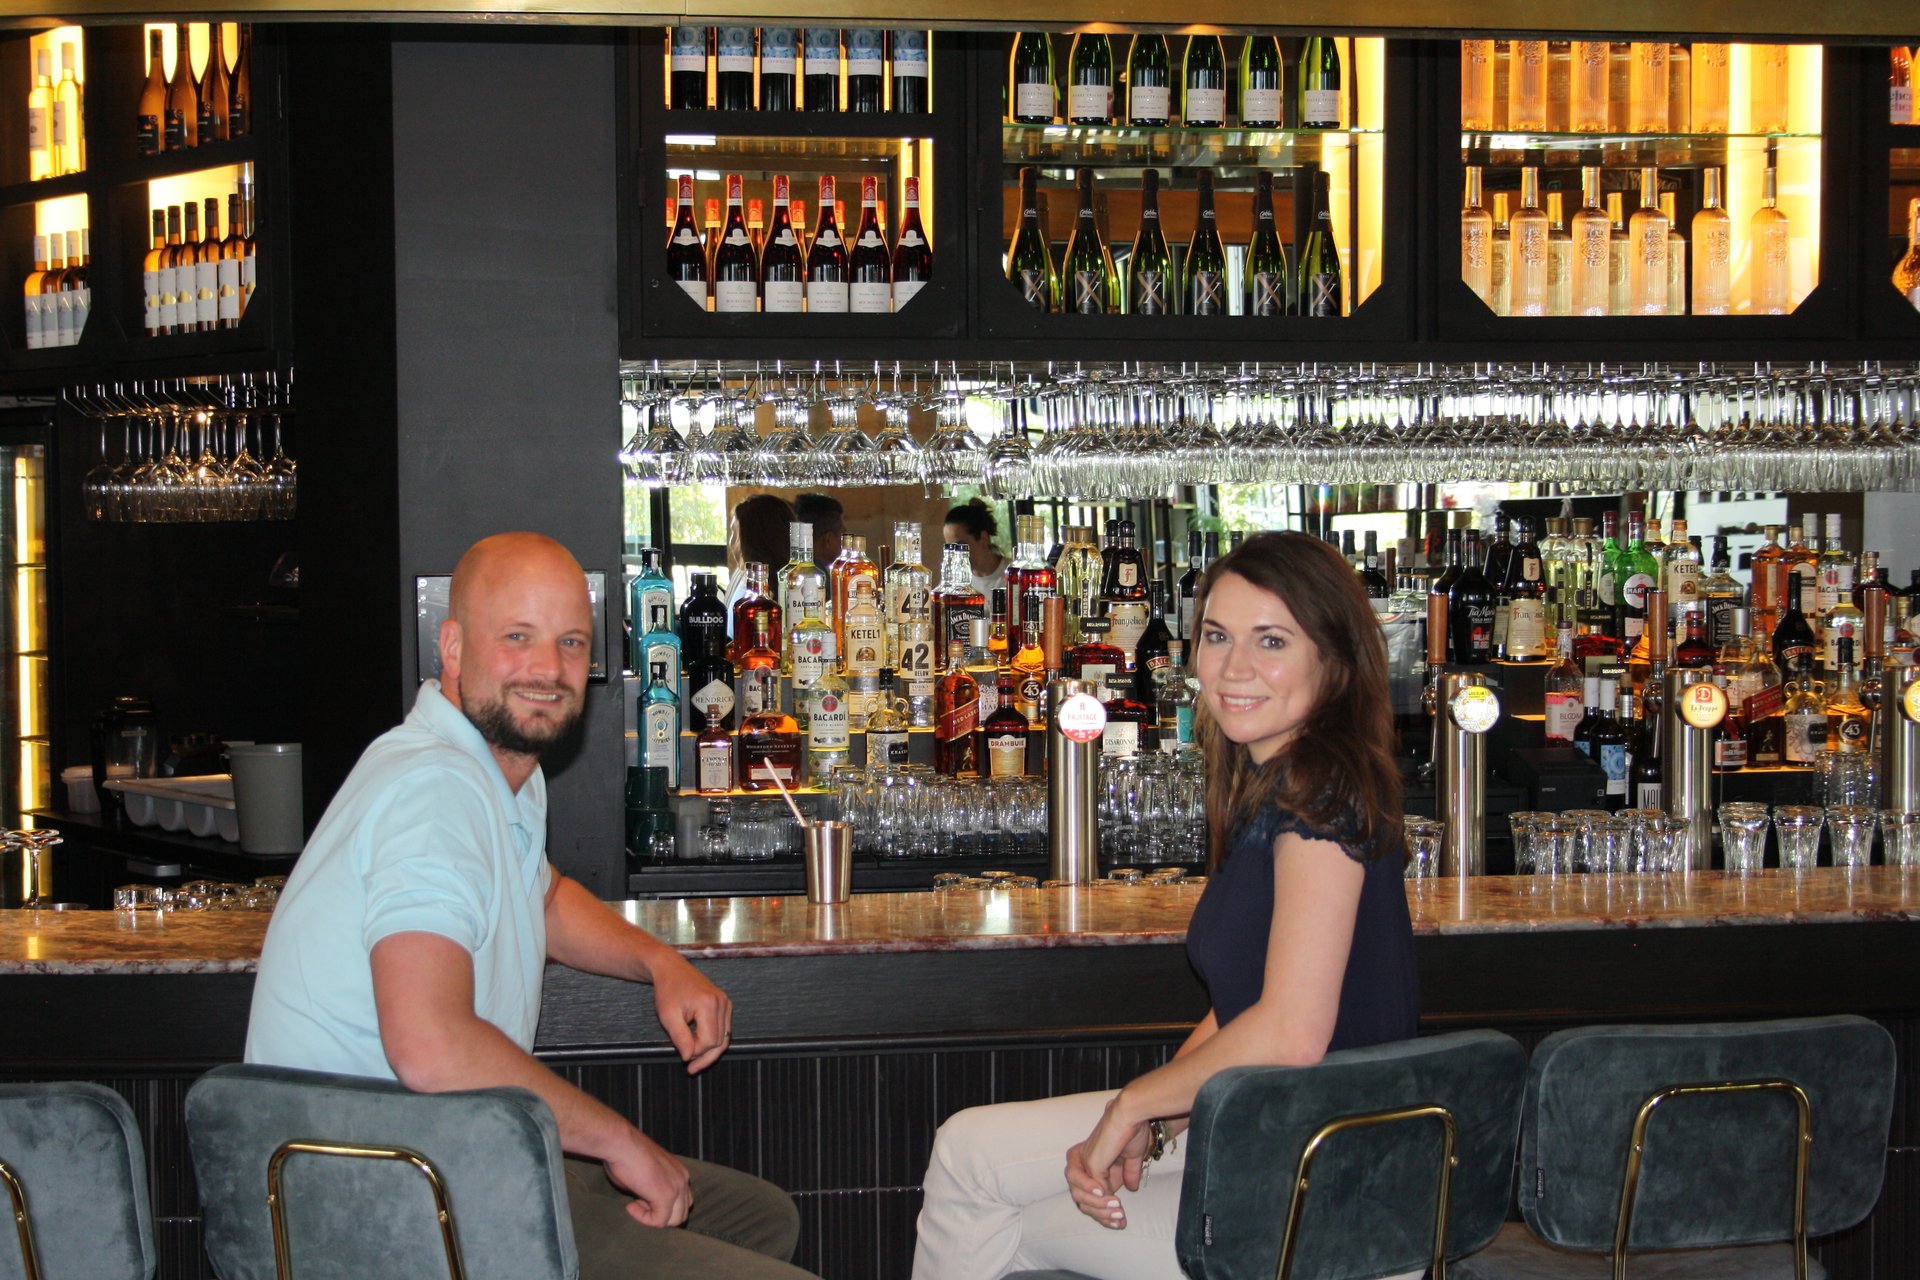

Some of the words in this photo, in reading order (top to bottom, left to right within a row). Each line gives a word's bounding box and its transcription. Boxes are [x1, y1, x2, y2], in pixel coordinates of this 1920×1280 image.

[1626, 587, 1645, 595] MART
[689, 616, 724, 624] BULLDOG
[950, 614, 963, 625] JACK
[798, 655, 823, 664] BACAR
[902, 643, 930, 671] 42
[1150, 657, 1169, 668] BAIL
[1023, 684, 1040, 697] 43
[952, 714, 965, 726] RED
[1560, 711, 1583, 720] BLOOM
[1844, 723, 1861, 736] 43
